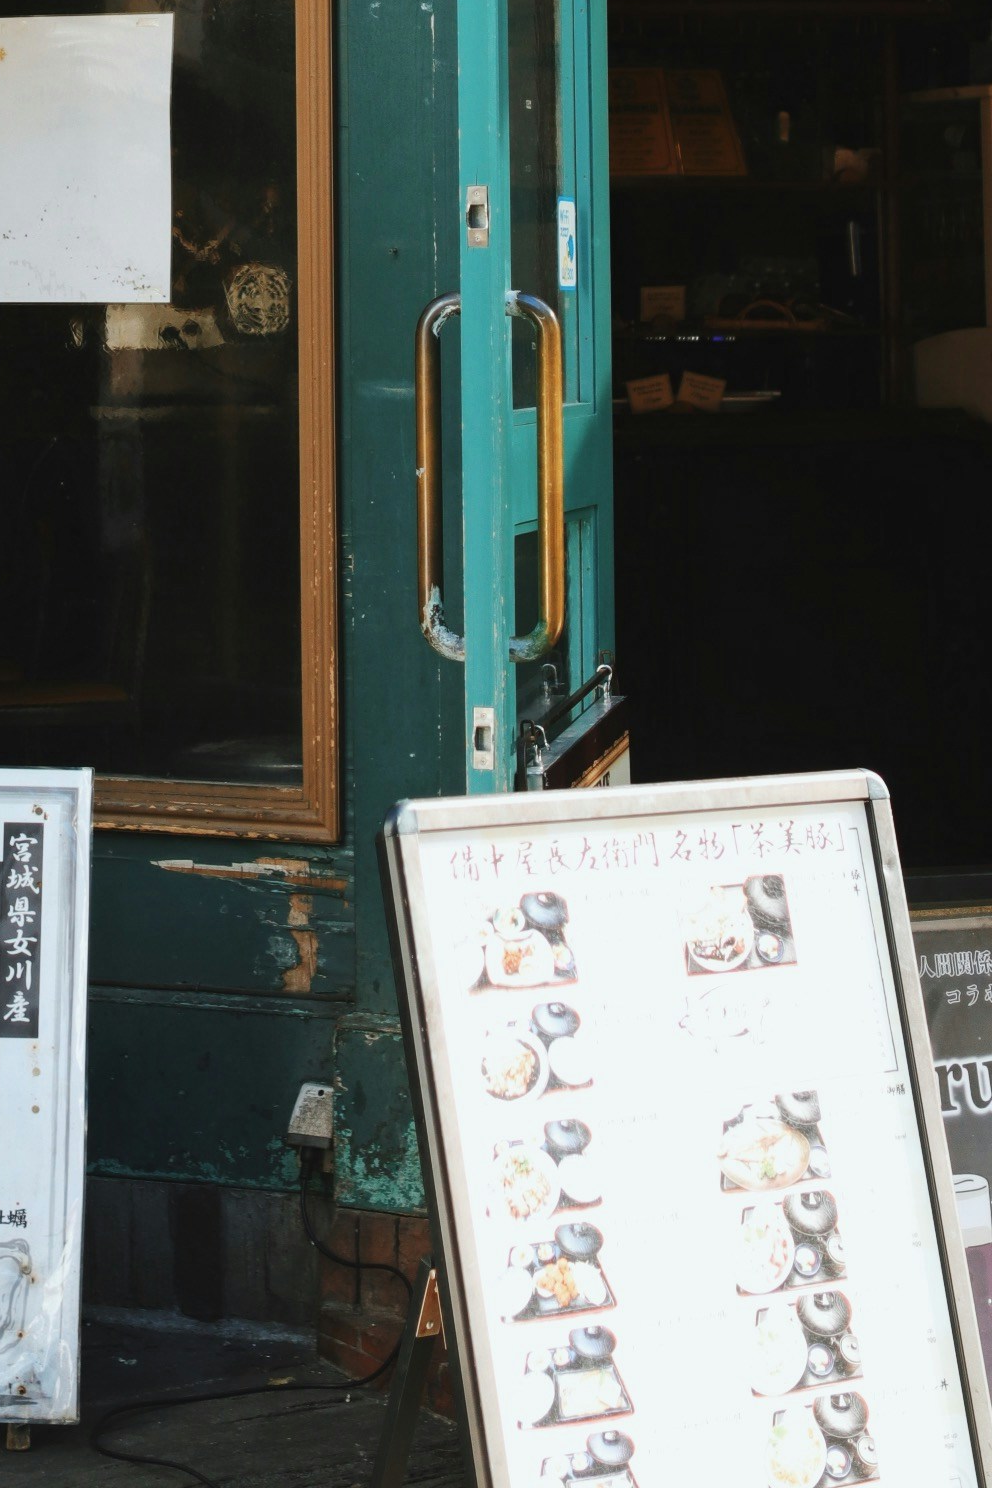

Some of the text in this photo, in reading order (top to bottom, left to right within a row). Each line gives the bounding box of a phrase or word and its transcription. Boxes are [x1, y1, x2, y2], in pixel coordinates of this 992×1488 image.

[3, 832, 41, 1024] 宮城県女川産
[918, 950, 992, 979] 人間関係
